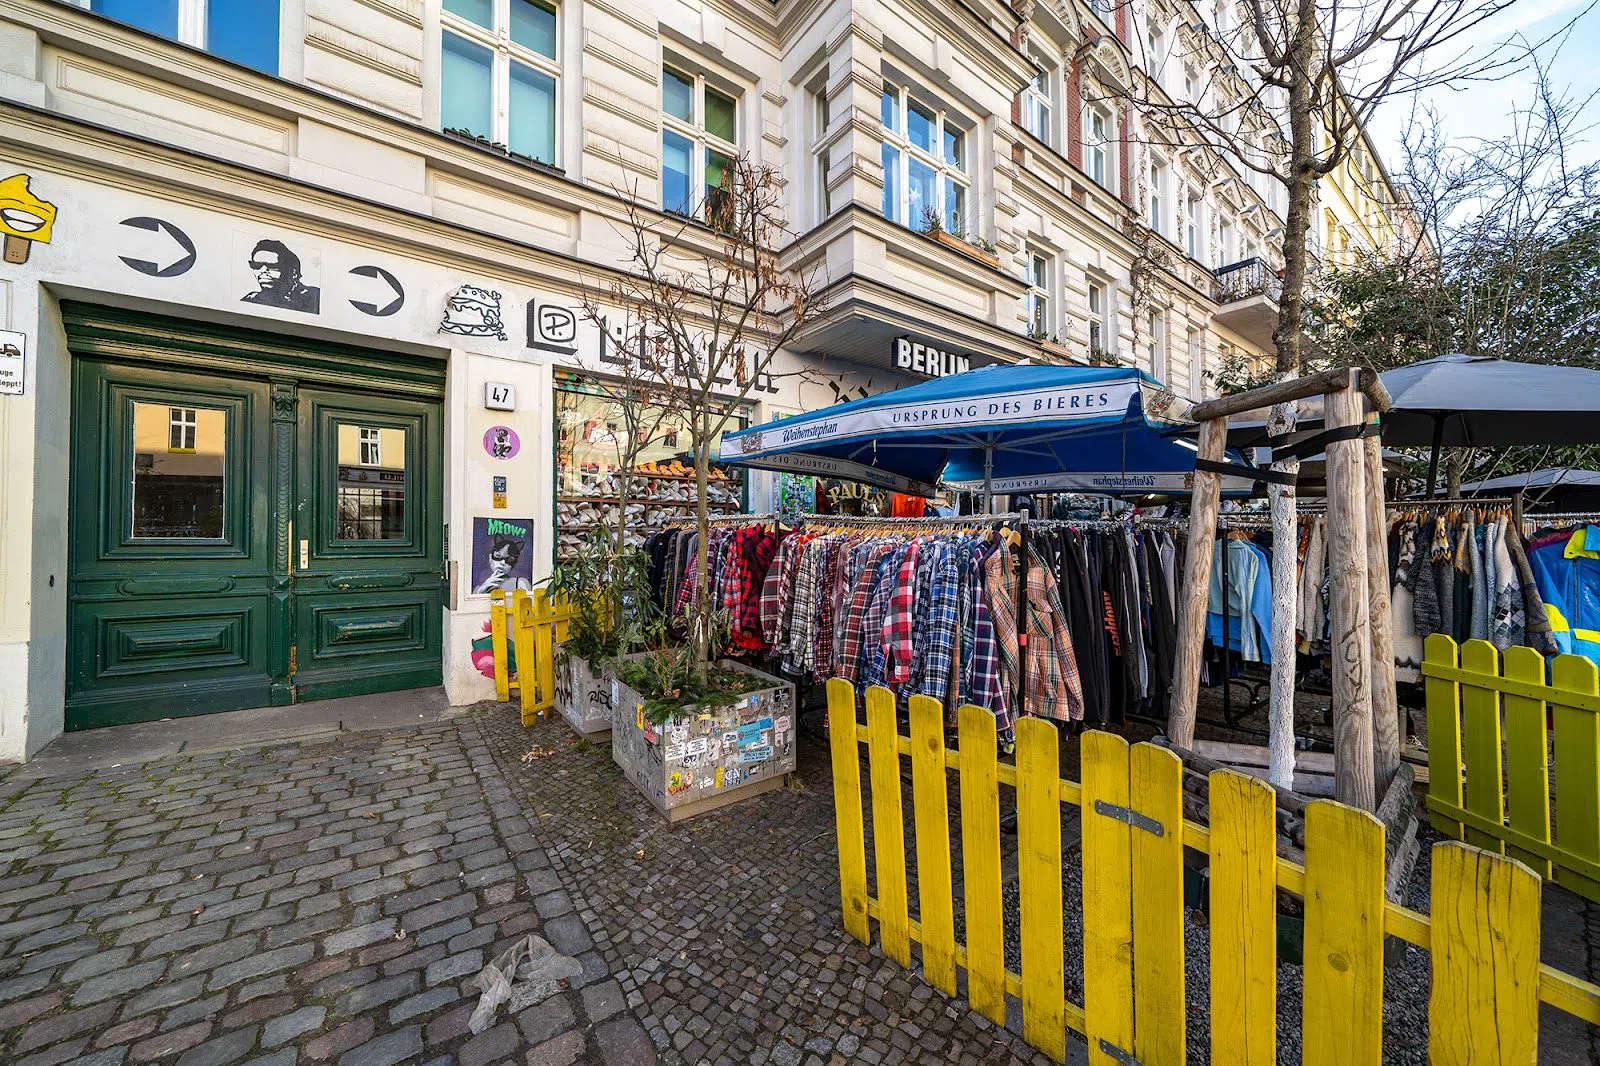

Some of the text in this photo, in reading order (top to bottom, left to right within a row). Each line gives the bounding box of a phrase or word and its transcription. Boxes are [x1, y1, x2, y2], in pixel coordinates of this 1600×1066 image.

[896, 338, 970, 377] BERLIN
[492, 387, 509, 403] 47
[893, 393, 1109, 423] URSPRUNG DES BIERES
[782, 422, 838, 443] Weihenstephan
[487, 518, 527, 538] MEOW!
